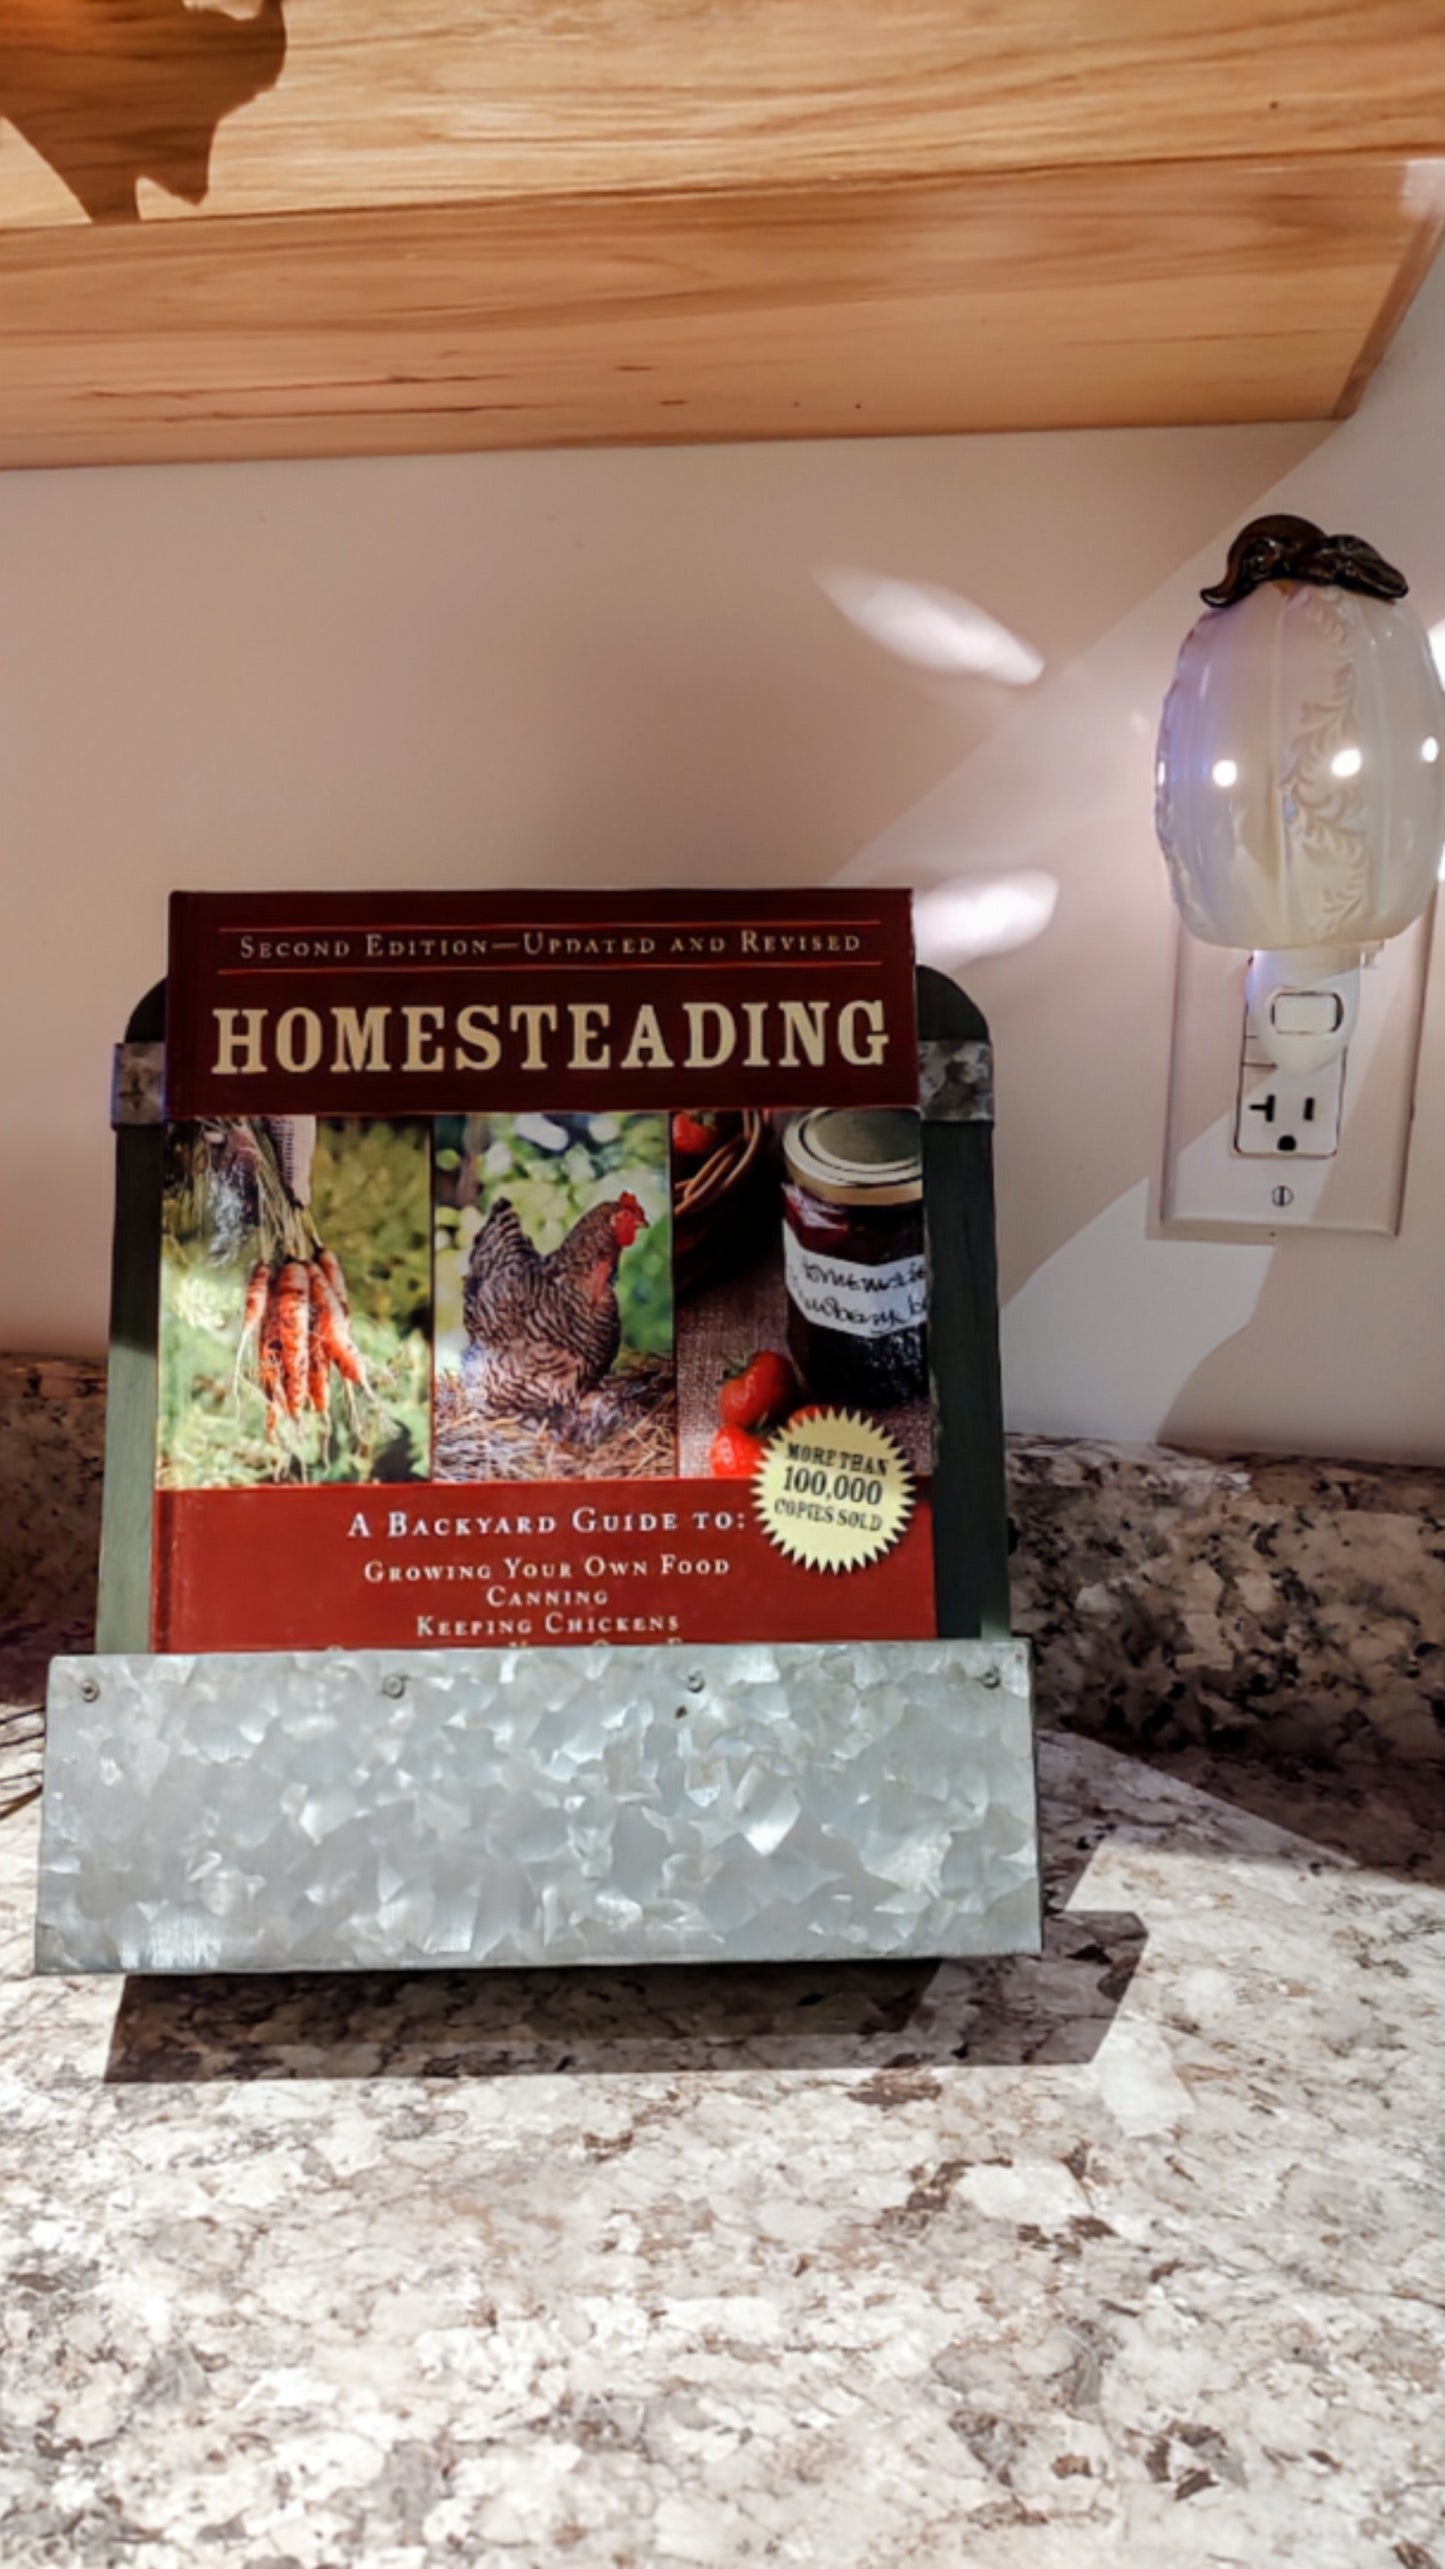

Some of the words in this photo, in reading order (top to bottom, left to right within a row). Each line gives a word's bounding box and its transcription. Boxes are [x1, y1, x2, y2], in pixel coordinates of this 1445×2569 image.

[240, 935, 350, 959] SECOND
[670, 937, 727, 954] AND
[741, 929, 862, 953] REVISED
[211, 999, 890, 1075] HOMESTEADING
[786, 1443, 835, 1467] MORE
[838, 1452, 889, 1475] THAN
[783, 1466, 882, 1505] 100,000
[348, 1512, 371, 1538] A
[388, 1511, 558, 1538] BACKYARD
[571, 1507, 679, 1535] GUIDE
[692, 1511, 746, 1531] TO:
[774, 1498, 834, 1523] COPIES
[837, 1508, 882, 1531] SOLD
[364, 1560, 492, 1583] GROWING
[503, 1558, 573, 1580] YOUR
[584, 1556, 649, 1577] OWN
[659, 1554, 732, 1576] FOOD
[486, 1586, 609, 1608] CANNING
[416, 1615, 532, 1637] KEEPING
[544, 1612, 681, 1634] CHICKENS
